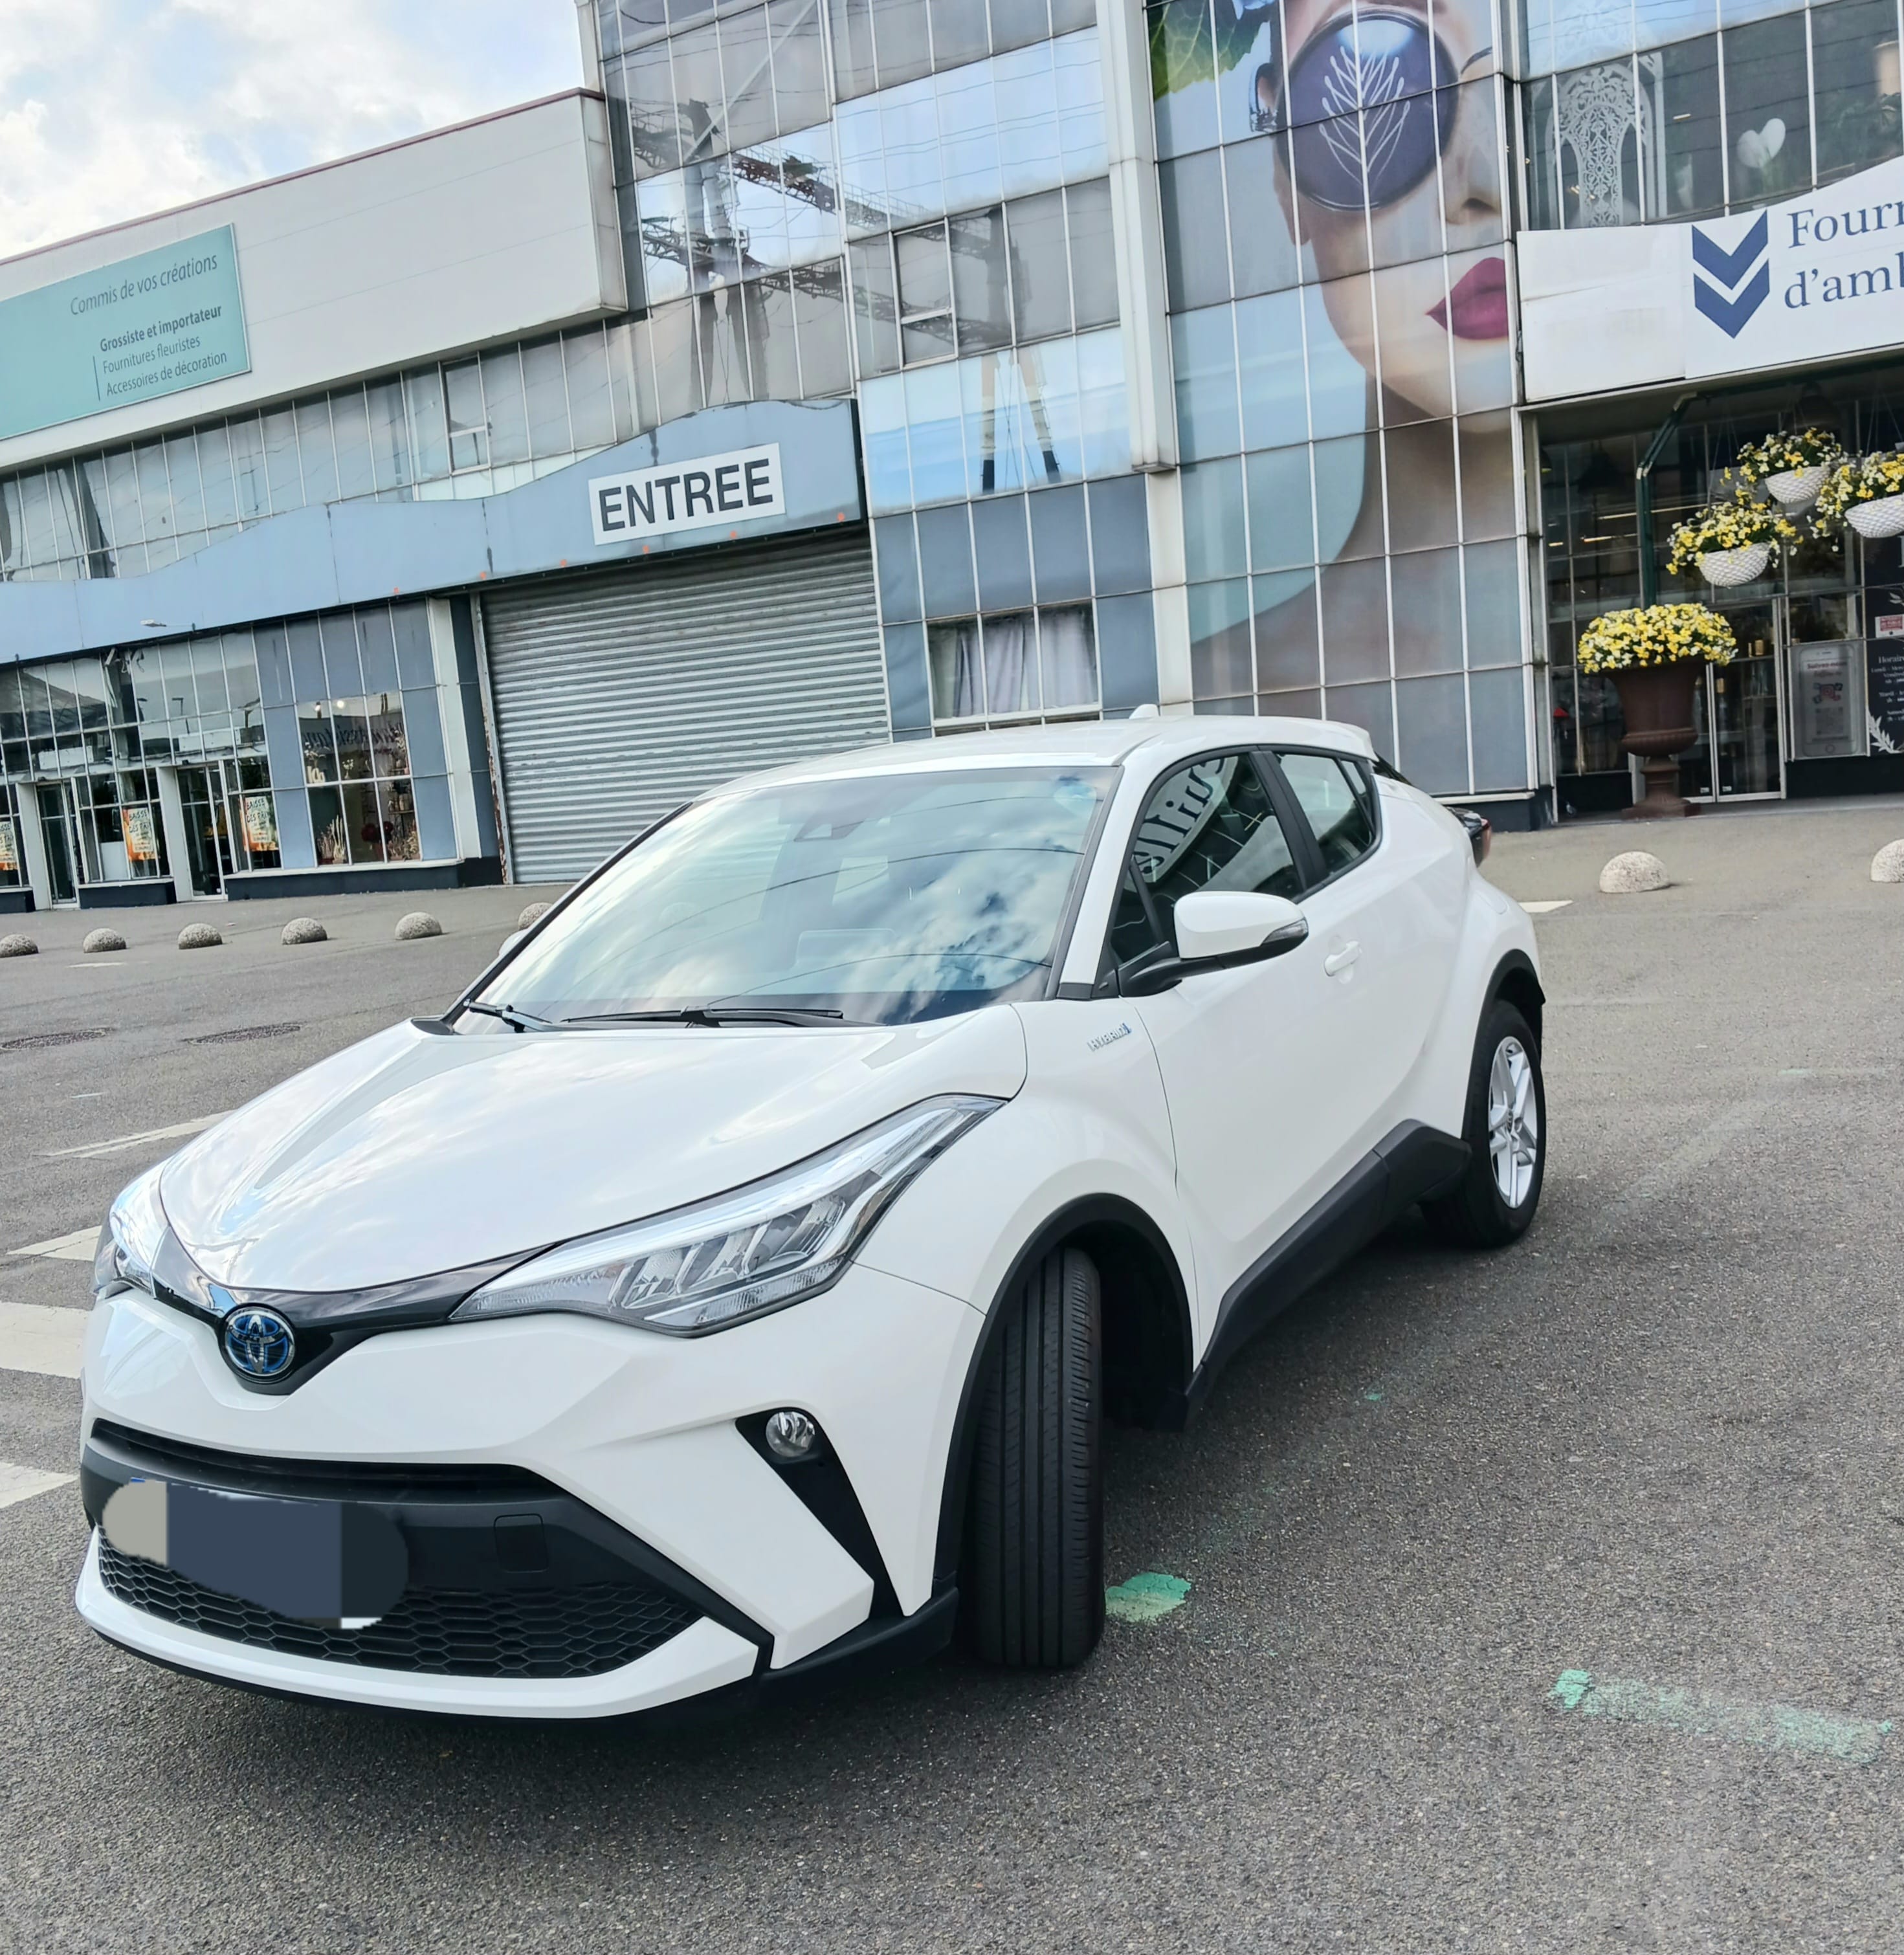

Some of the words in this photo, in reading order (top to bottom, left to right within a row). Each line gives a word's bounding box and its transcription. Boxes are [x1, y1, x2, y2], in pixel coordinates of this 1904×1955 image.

[70, 286, 117, 315] Commis
[120, 280, 135, 300] de
[137, 275, 157, 294] vos
[161, 255, 217, 287] créations
[100, 331, 145, 352] Grossiste
[147, 324, 157, 338] et
[159, 305, 222, 334] importateur
[103, 349, 155, 374] Fournitures
[157, 336, 201, 358] fleuristes
[107, 371, 159, 397] Accessoires
[161, 366, 173, 381] de
[175, 352, 227, 377] décoration
[598, 458, 773, 532] ENTREE
